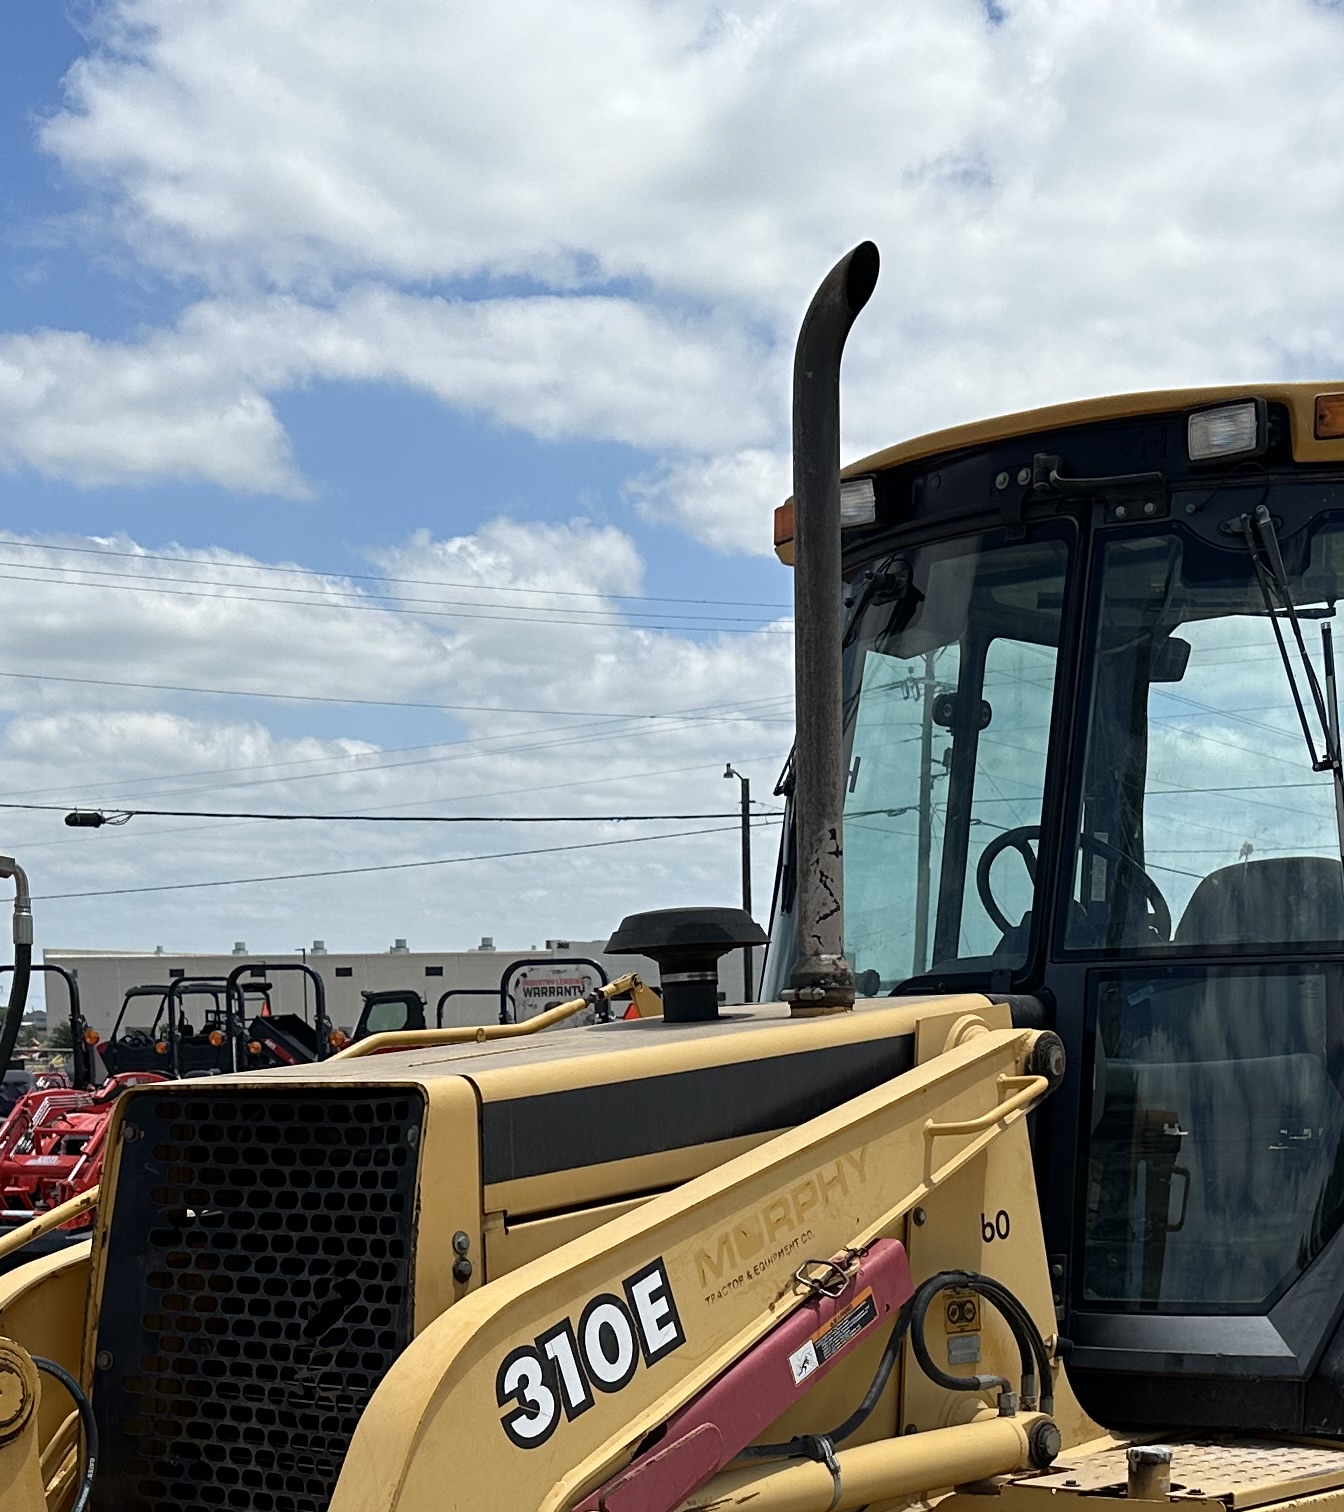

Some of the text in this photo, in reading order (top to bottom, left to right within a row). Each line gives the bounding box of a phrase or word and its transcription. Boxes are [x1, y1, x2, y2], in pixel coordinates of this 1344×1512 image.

[523, 984, 585, 998] WARRANTY
[692, 1148, 868, 1289] MURPHY
[705, 1229, 814, 1306] TRACTOR & EQUIPMENT CO.
[500, 1263, 682, 1443] 310E
